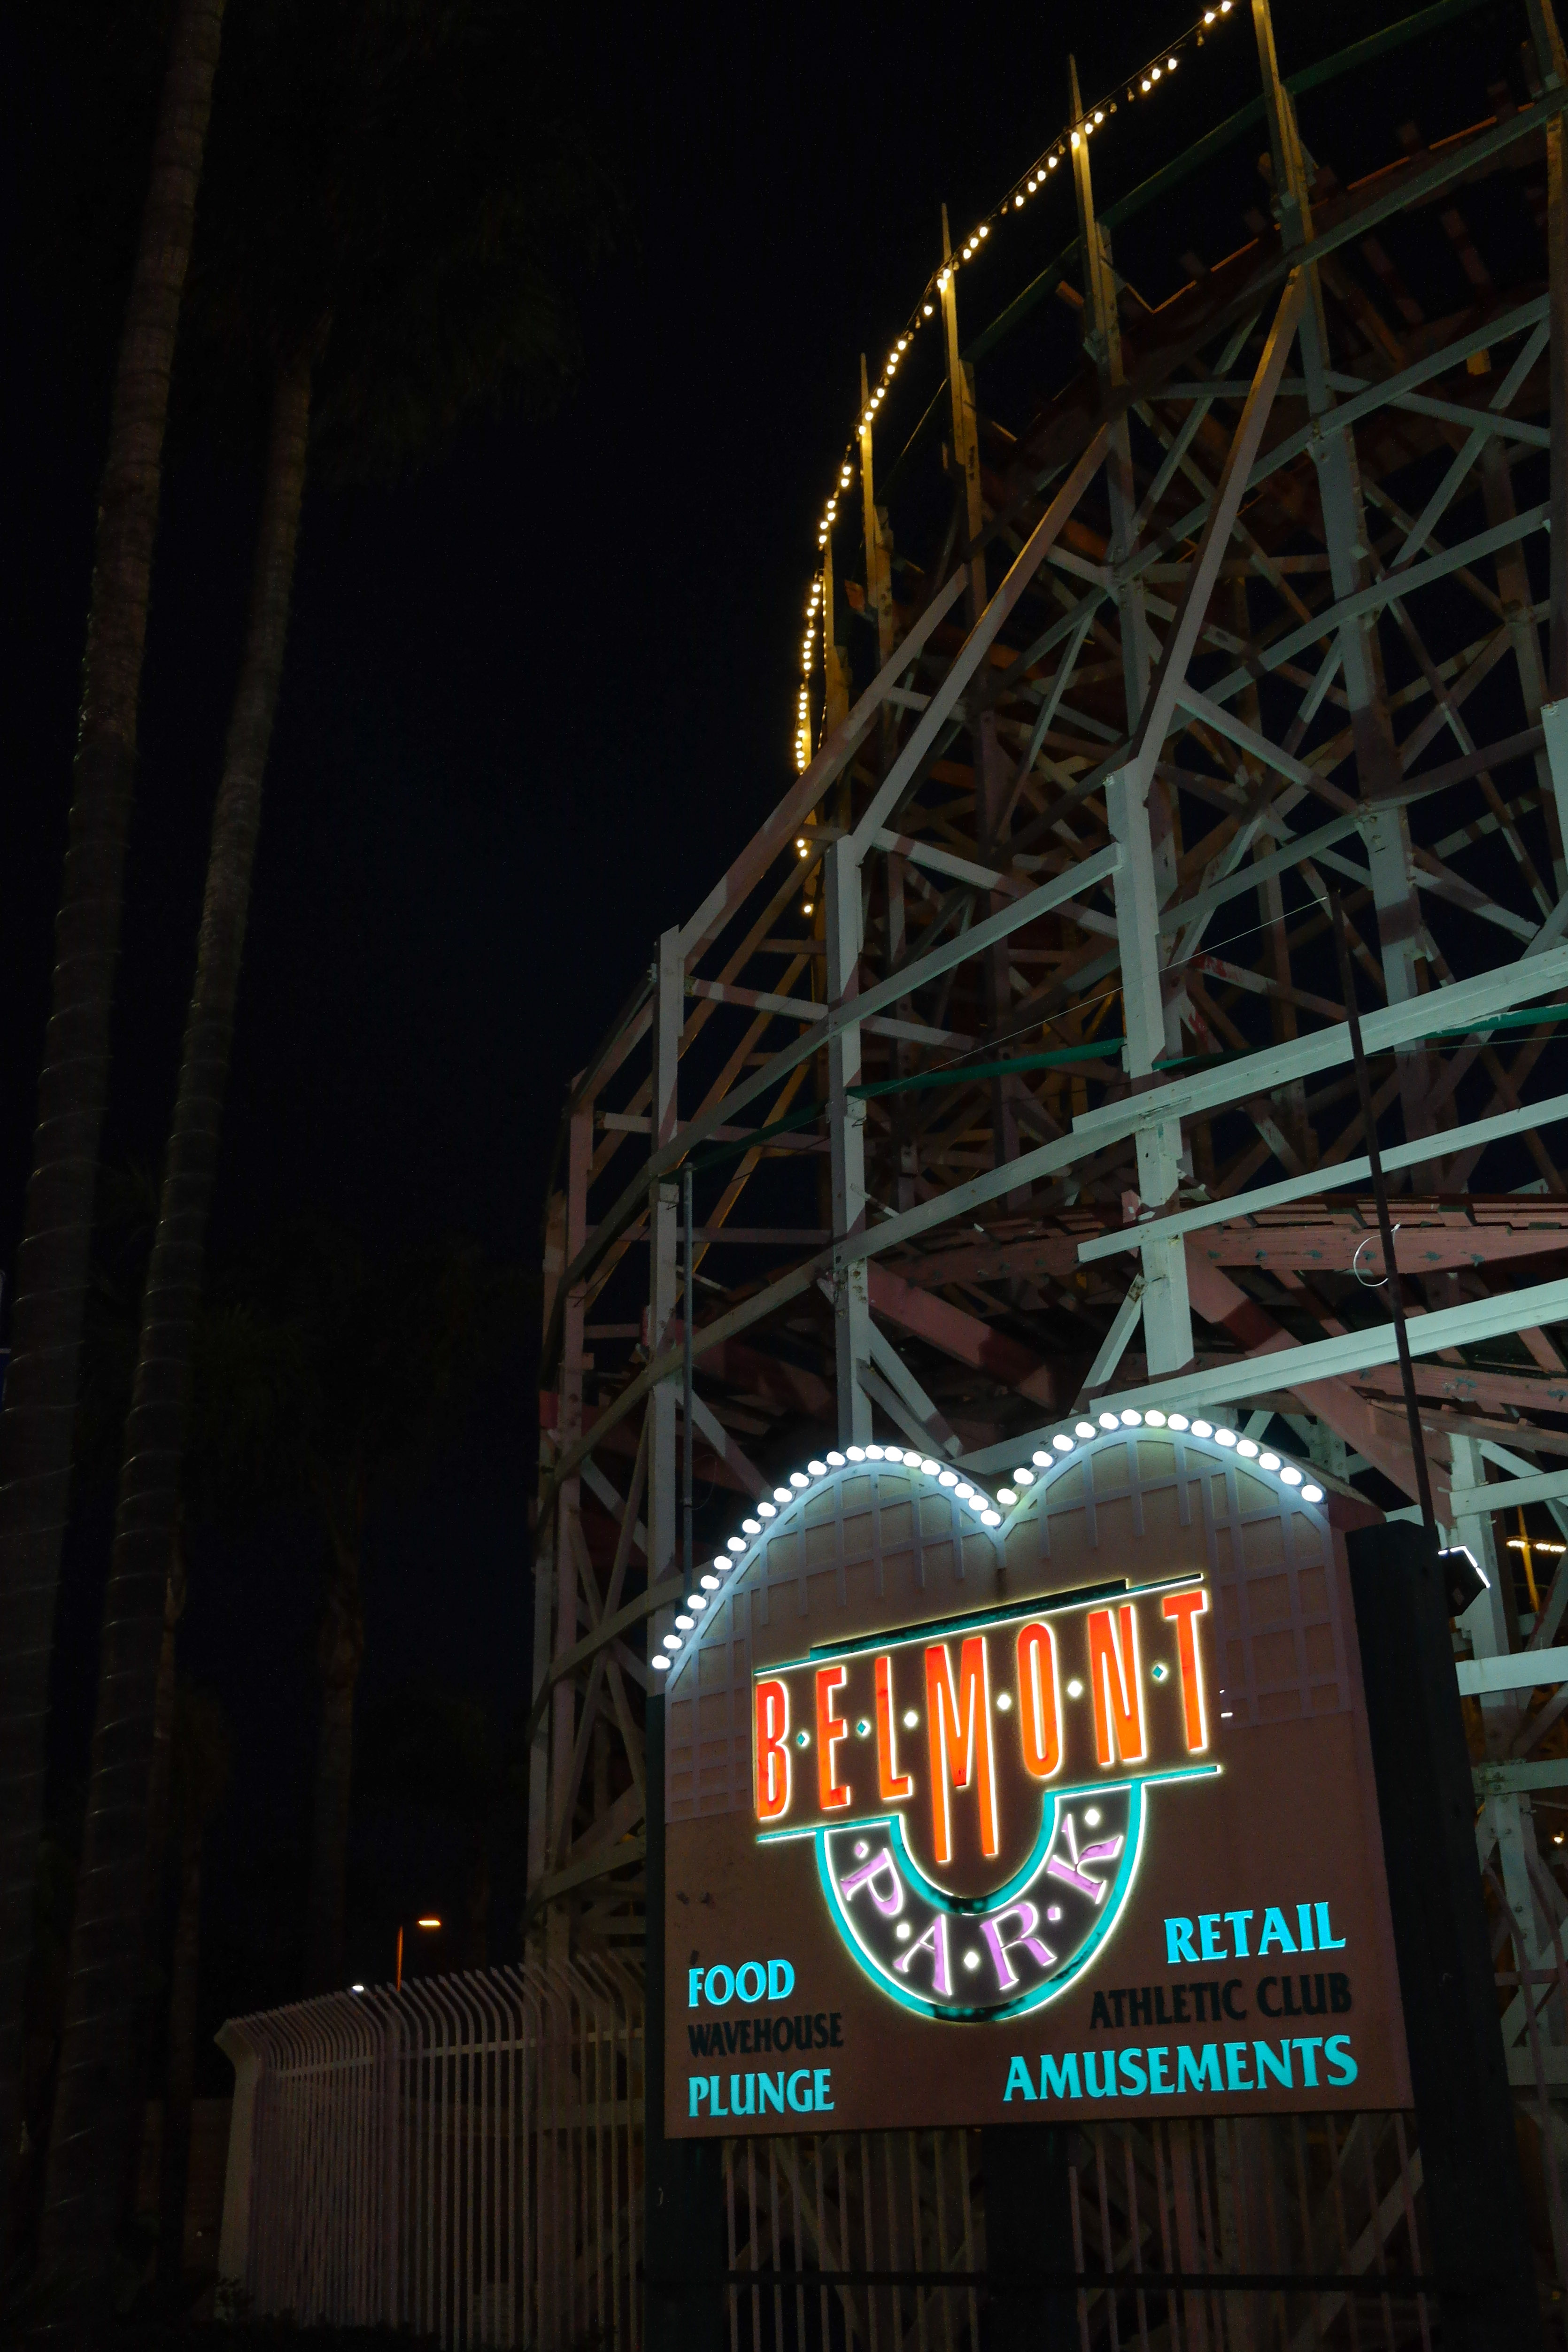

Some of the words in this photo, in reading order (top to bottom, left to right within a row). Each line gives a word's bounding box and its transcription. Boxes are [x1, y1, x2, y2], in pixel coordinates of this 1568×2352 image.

[1164, 1901, 1346, 1964] RETAIL
[688, 1959, 795, 2007] FOOD
[1089, 1979, 1247, 2029] ATHLETIC
[1257, 1972, 1352, 2018] CLUB
[687, 2012, 844, 2057] WAVEHOUSE
[688, 2068, 835, 2117] PLUNGE
[1003, 2034, 1359, 2102] AMUSEMENTS
